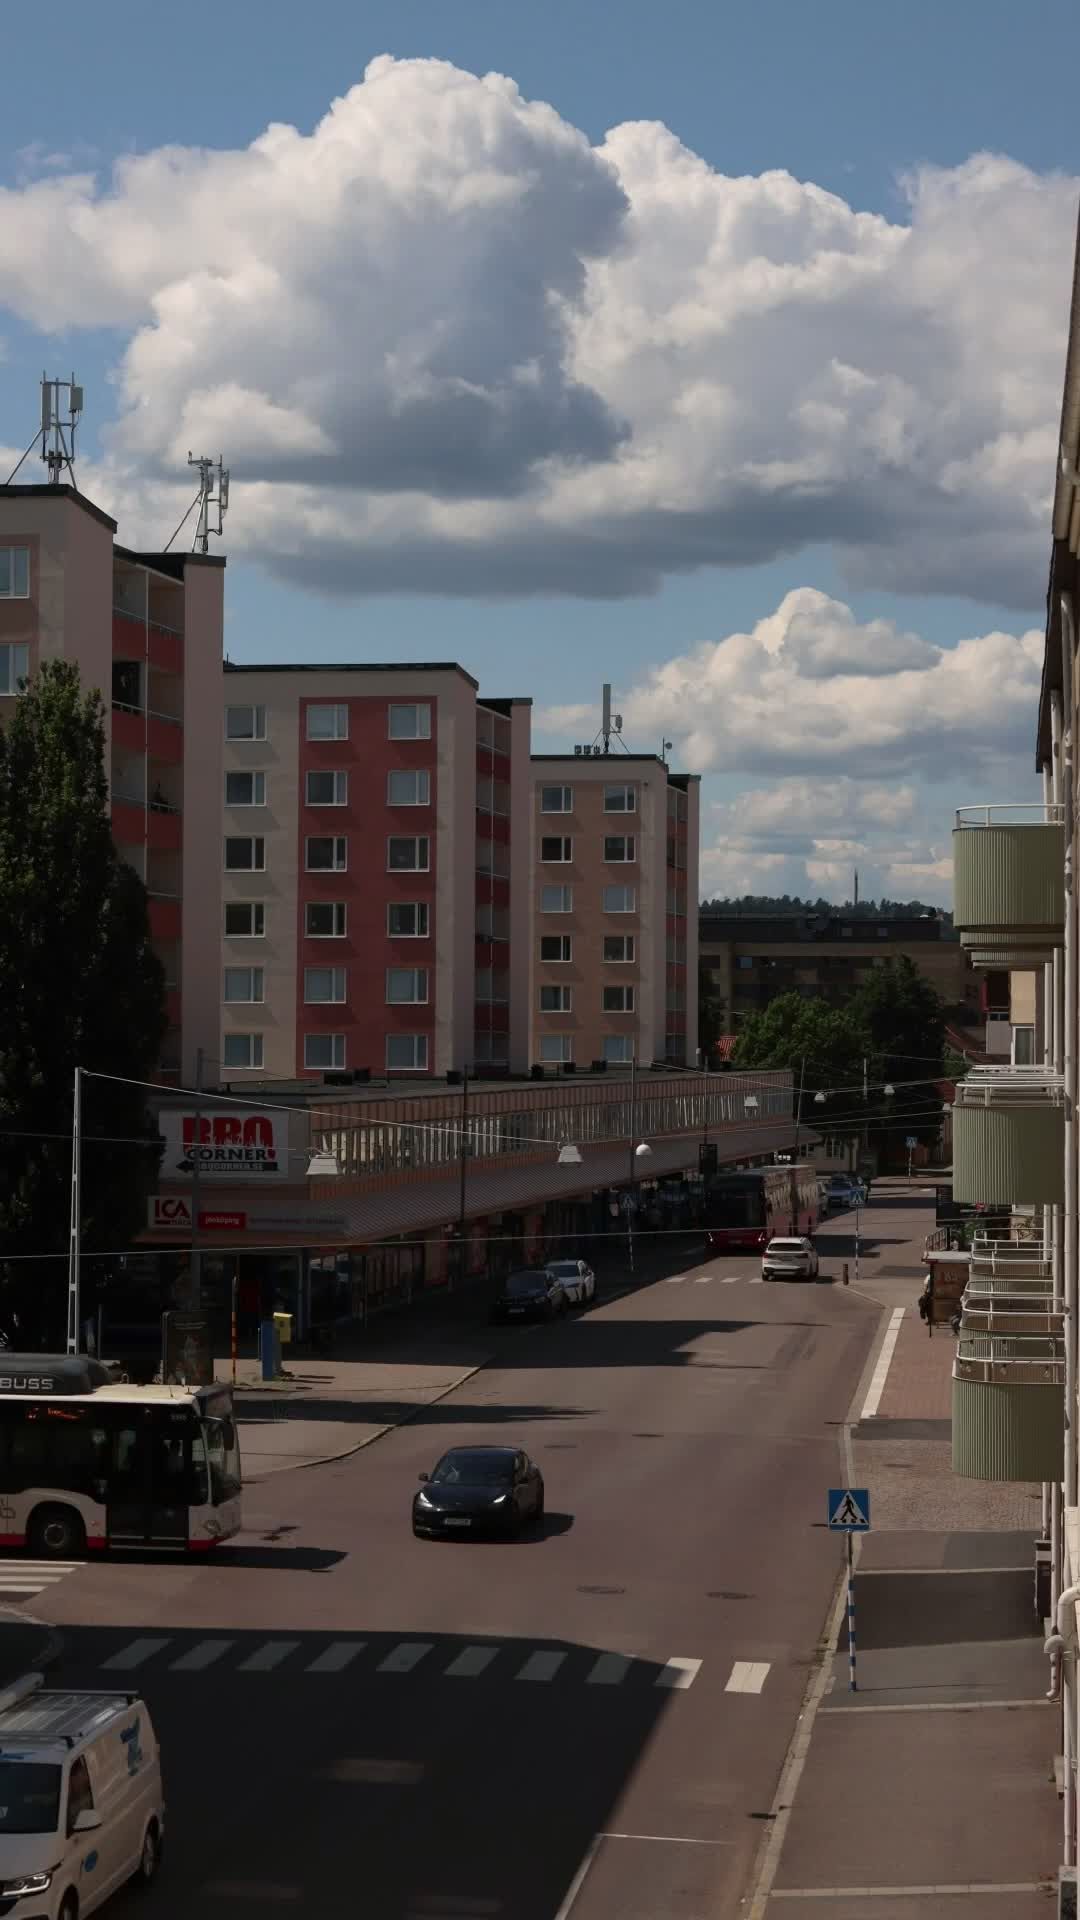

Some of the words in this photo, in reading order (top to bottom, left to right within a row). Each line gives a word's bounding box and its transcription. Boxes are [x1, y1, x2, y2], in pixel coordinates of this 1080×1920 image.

[187, 1150, 266, 1161] CORNER
[155, 1200, 191, 1219] ICA
[0, 1378, 54, 1390] BUSS
